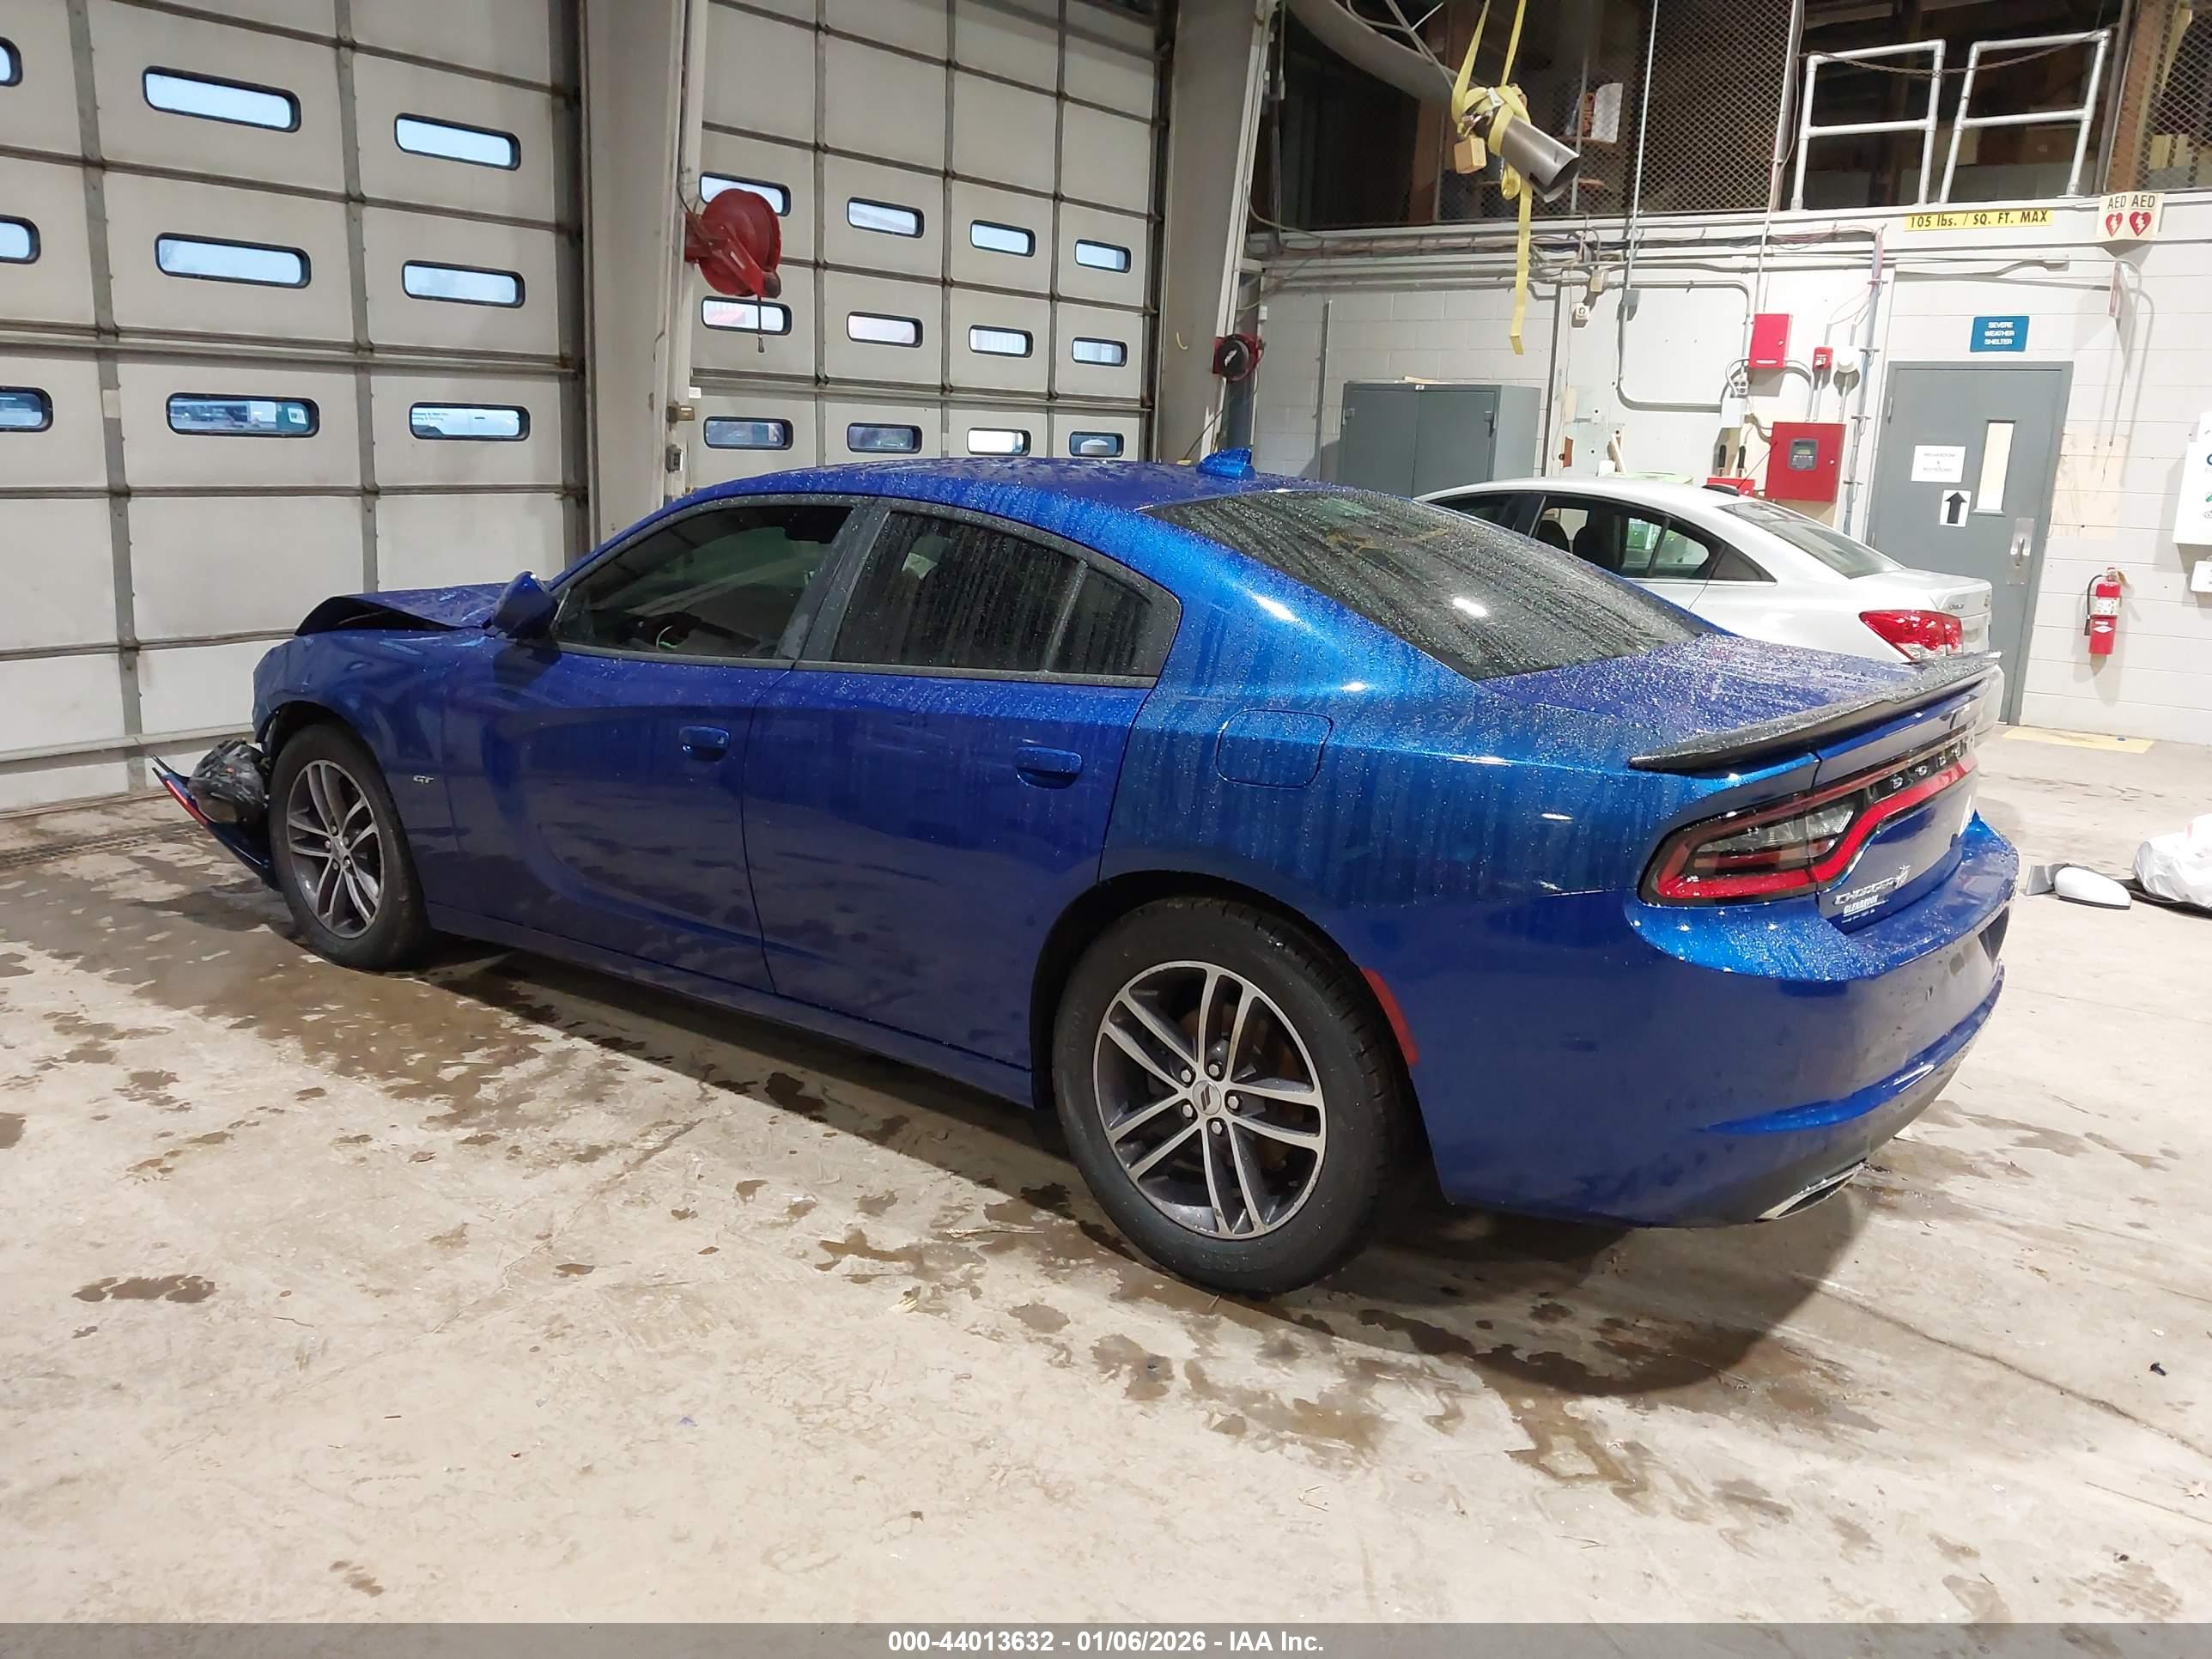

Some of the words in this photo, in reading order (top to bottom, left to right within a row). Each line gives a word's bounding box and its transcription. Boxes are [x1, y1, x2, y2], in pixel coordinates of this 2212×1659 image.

[2107, 195, 2127, 210] AED
[2131, 194, 2156, 208] AED
[1911, 216, 1932, 228] 105
[1936, 213, 1957, 227] lbs.
[1962, 212, 1969, 226] /
[1973, 213, 1991, 225] SQ.
[1997, 212, 2014, 224] FT.
[2021, 210, 2048, 222] MAX
[413, 775, 434, 784] GT
